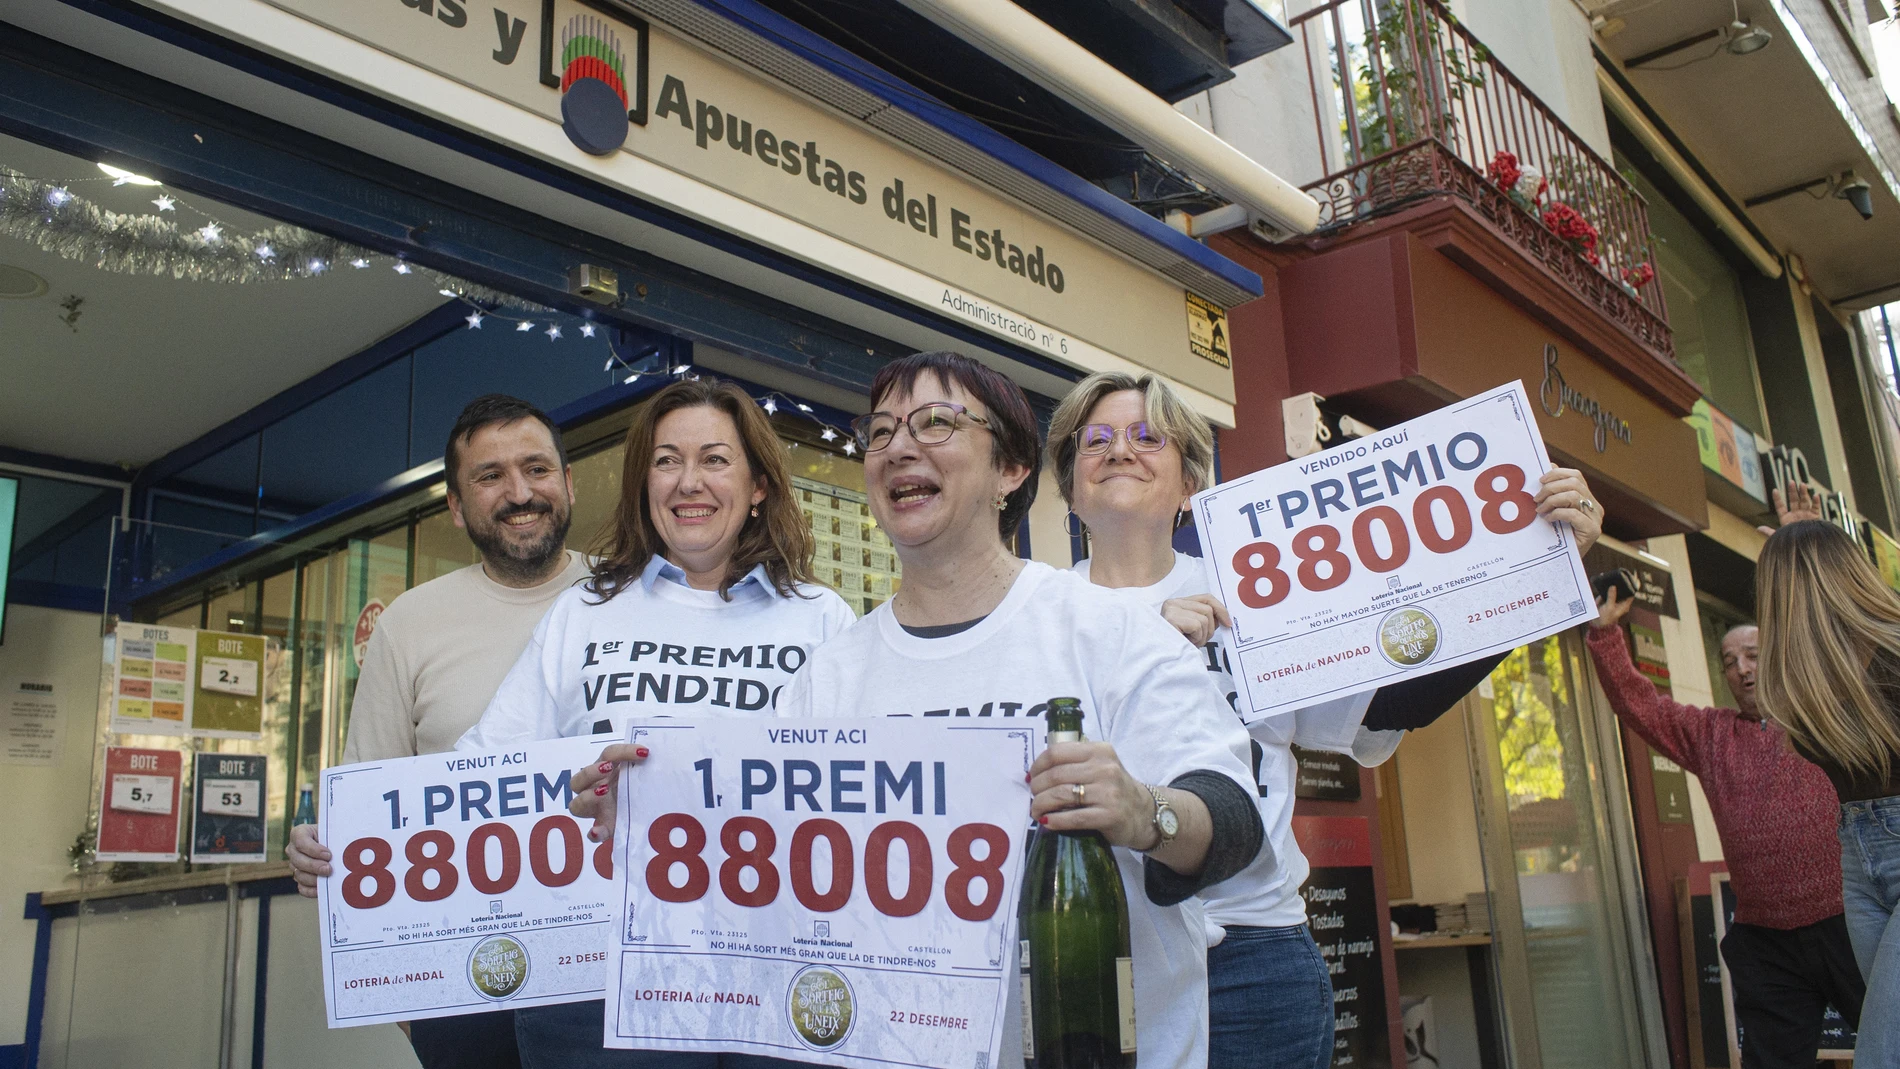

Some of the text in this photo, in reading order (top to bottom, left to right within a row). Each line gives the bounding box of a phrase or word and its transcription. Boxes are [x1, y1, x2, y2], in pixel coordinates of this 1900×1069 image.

[492, 7, 527, 65] y
[655, 74, 1065, 293] Apuestas del Estado
[1060, 338, 1068, 355] 6
[1192, 343, 1229, 367] PROSEGUR
[1300, 428, 1409, 476] VENDIDO AQUÍ
[1238, 431, 1488, 538] 1er PREMIO
[1232, 463, 1538, 609] 88008
[1467, 556, 1504, 572] CASTELLÓN
[1309, 571, 1488, 629] NO HAY MAYOR SUERTE QUE LA DE TENERNOS
[1371, 582, 1423, 602] Lotería Nacional
[1468, 590, 1550, 625] 22 DICIEMBRE
[143, 628, 169, 640] BOTES
[218, 638, 243, 654] BOTE
[581, 641, 807, 674] 1er PREMIO
[1257, 645, 1371, 683] LOTERÍA de NAVIDAD
[218, 669, 239, 684] 2,2
[583, 672, 784, 712] VENDID
[768, 729, 867, 744] VENUT ACI
[130, 755, 159, 770] BOTE
[219, 759, 246, 775] BOTE
[446, 752, 527, 772] VENUT ACI
[131, 787, 153, 803] 5,7
[694, 758, 947, 816] 1r PREMI
[221, 792, 242, 806] 53
[383, 769, 574, 829] 1r PREM
[645, 812, 1011, 922] 88008
[1308, 885, 1347, 906] Desayunos
[568, 902, 605, 911] CASTELLÓN
[398, 933, 411, 941] NO
[422, 930, 434, 938] HA
[435, 928, 457, 936] SORT
[458, 924, 476, 934] MÉS
[477, 924, 499, 932] GRAN
[501, 921, 518, 930] QUE
[544, 912, 593, 924] TINDRE-NOS
[471, 911, 523, 923] Lotería Nacional
[1311, 910, 1344, 930] Tostadas
[793, 936, 852, 948] Lotería Nacional
[908, 945, 951, 955] CASTELLÓN
[1337, 937, 1346, 955] de
[1347, 935, 1374, 958] naranja
[558, 951, 607, 965] 22 DESE
[710, 941, 936, 968] NO HI HA SORT MÉS GRAN QUE LA DE TINDRE-NOS
[344, 970, 444, 990] LOTERIA de NADAL
[635, 989, 761, 1007] LOTERIA de NADAL
[890, 1010, 969, 1031] 22 DESEMBRE
